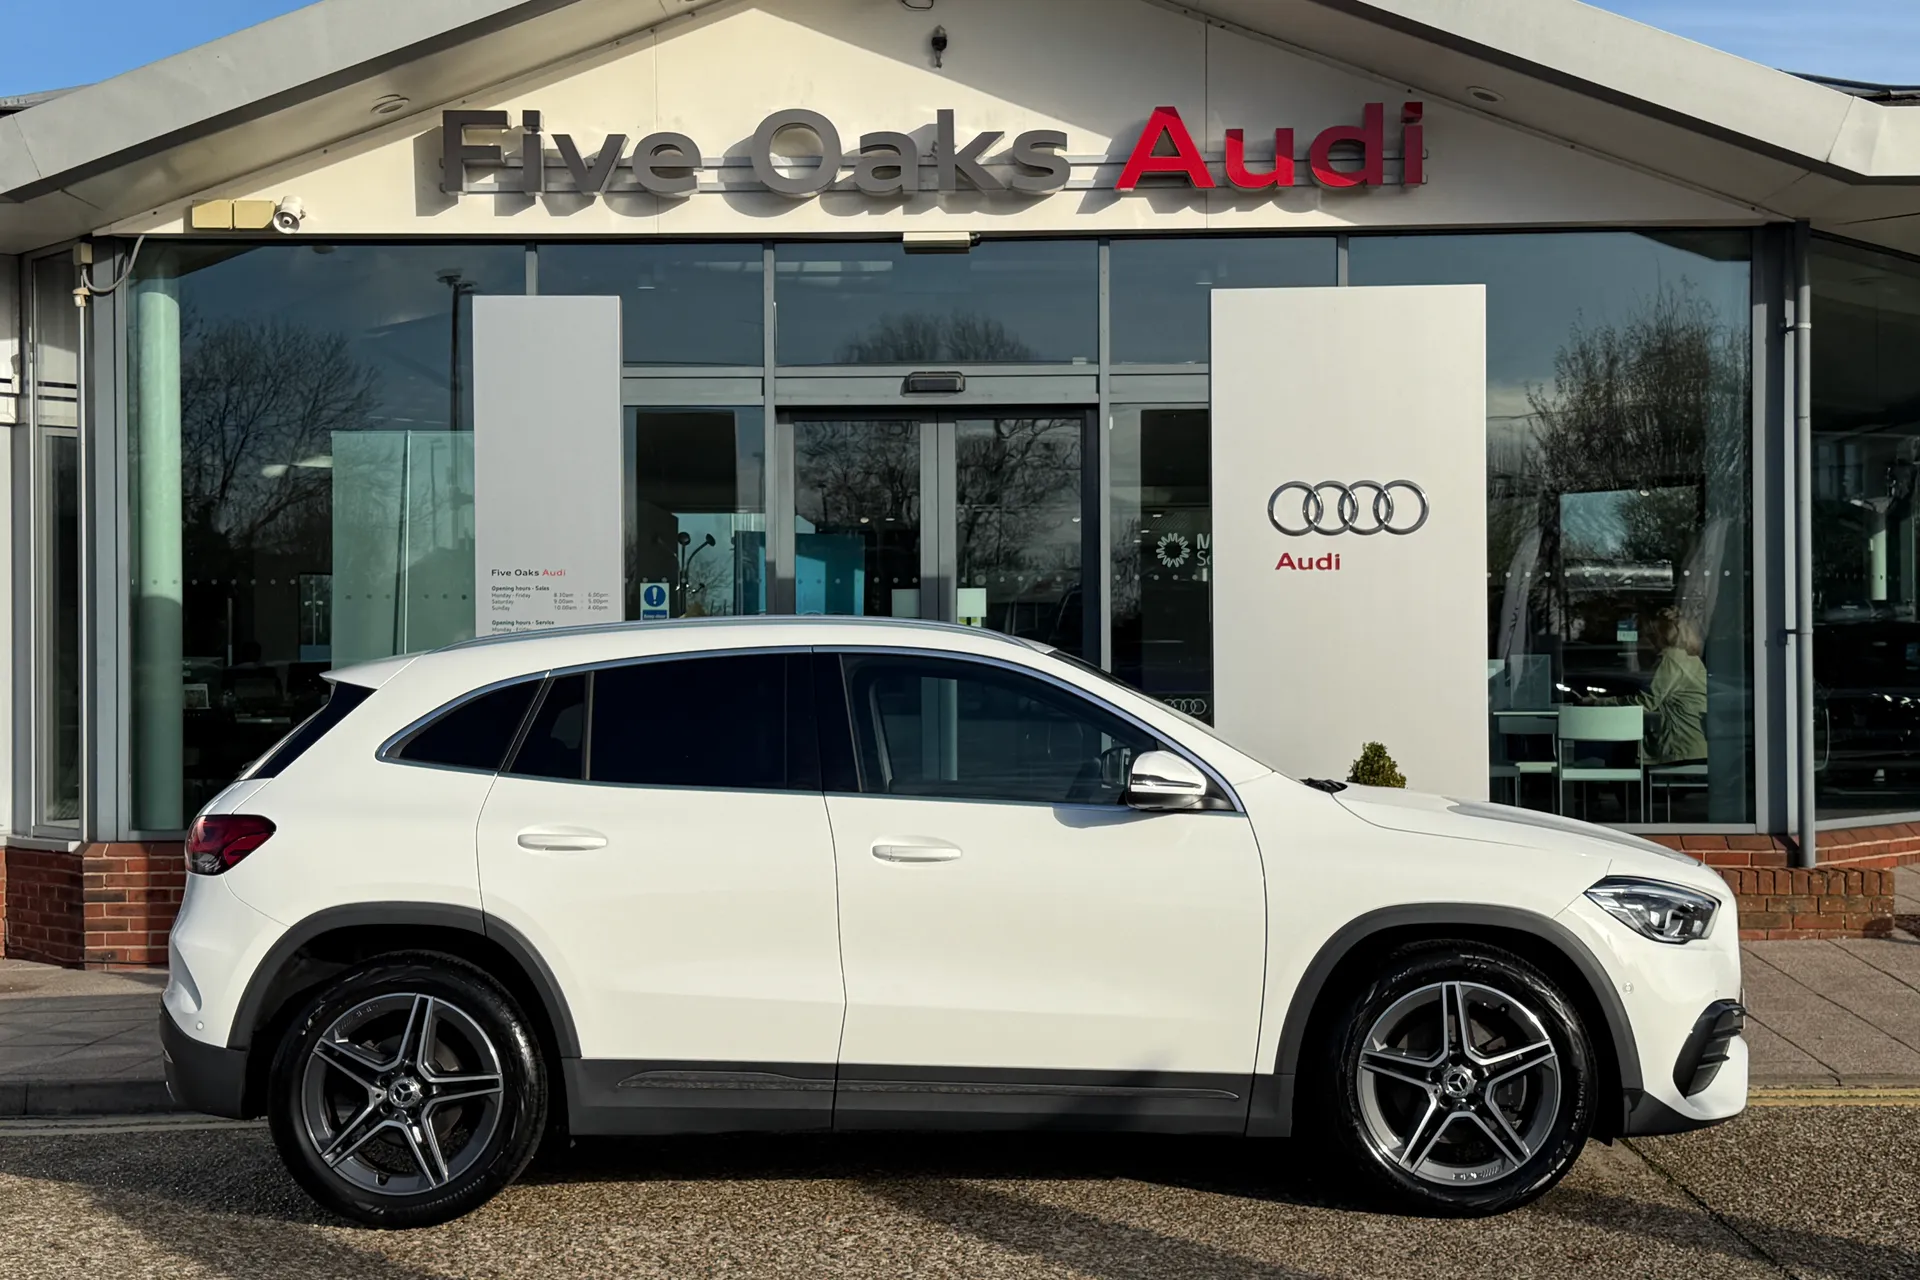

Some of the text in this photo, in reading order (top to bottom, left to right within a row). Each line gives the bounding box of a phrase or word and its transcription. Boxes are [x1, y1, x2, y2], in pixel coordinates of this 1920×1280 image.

[442, 101, 1423, 197] Five Oaks Audi
[1275, 552, 1341, 571] Audi
[491, 568, 566, 577] Five Oaks Audi
